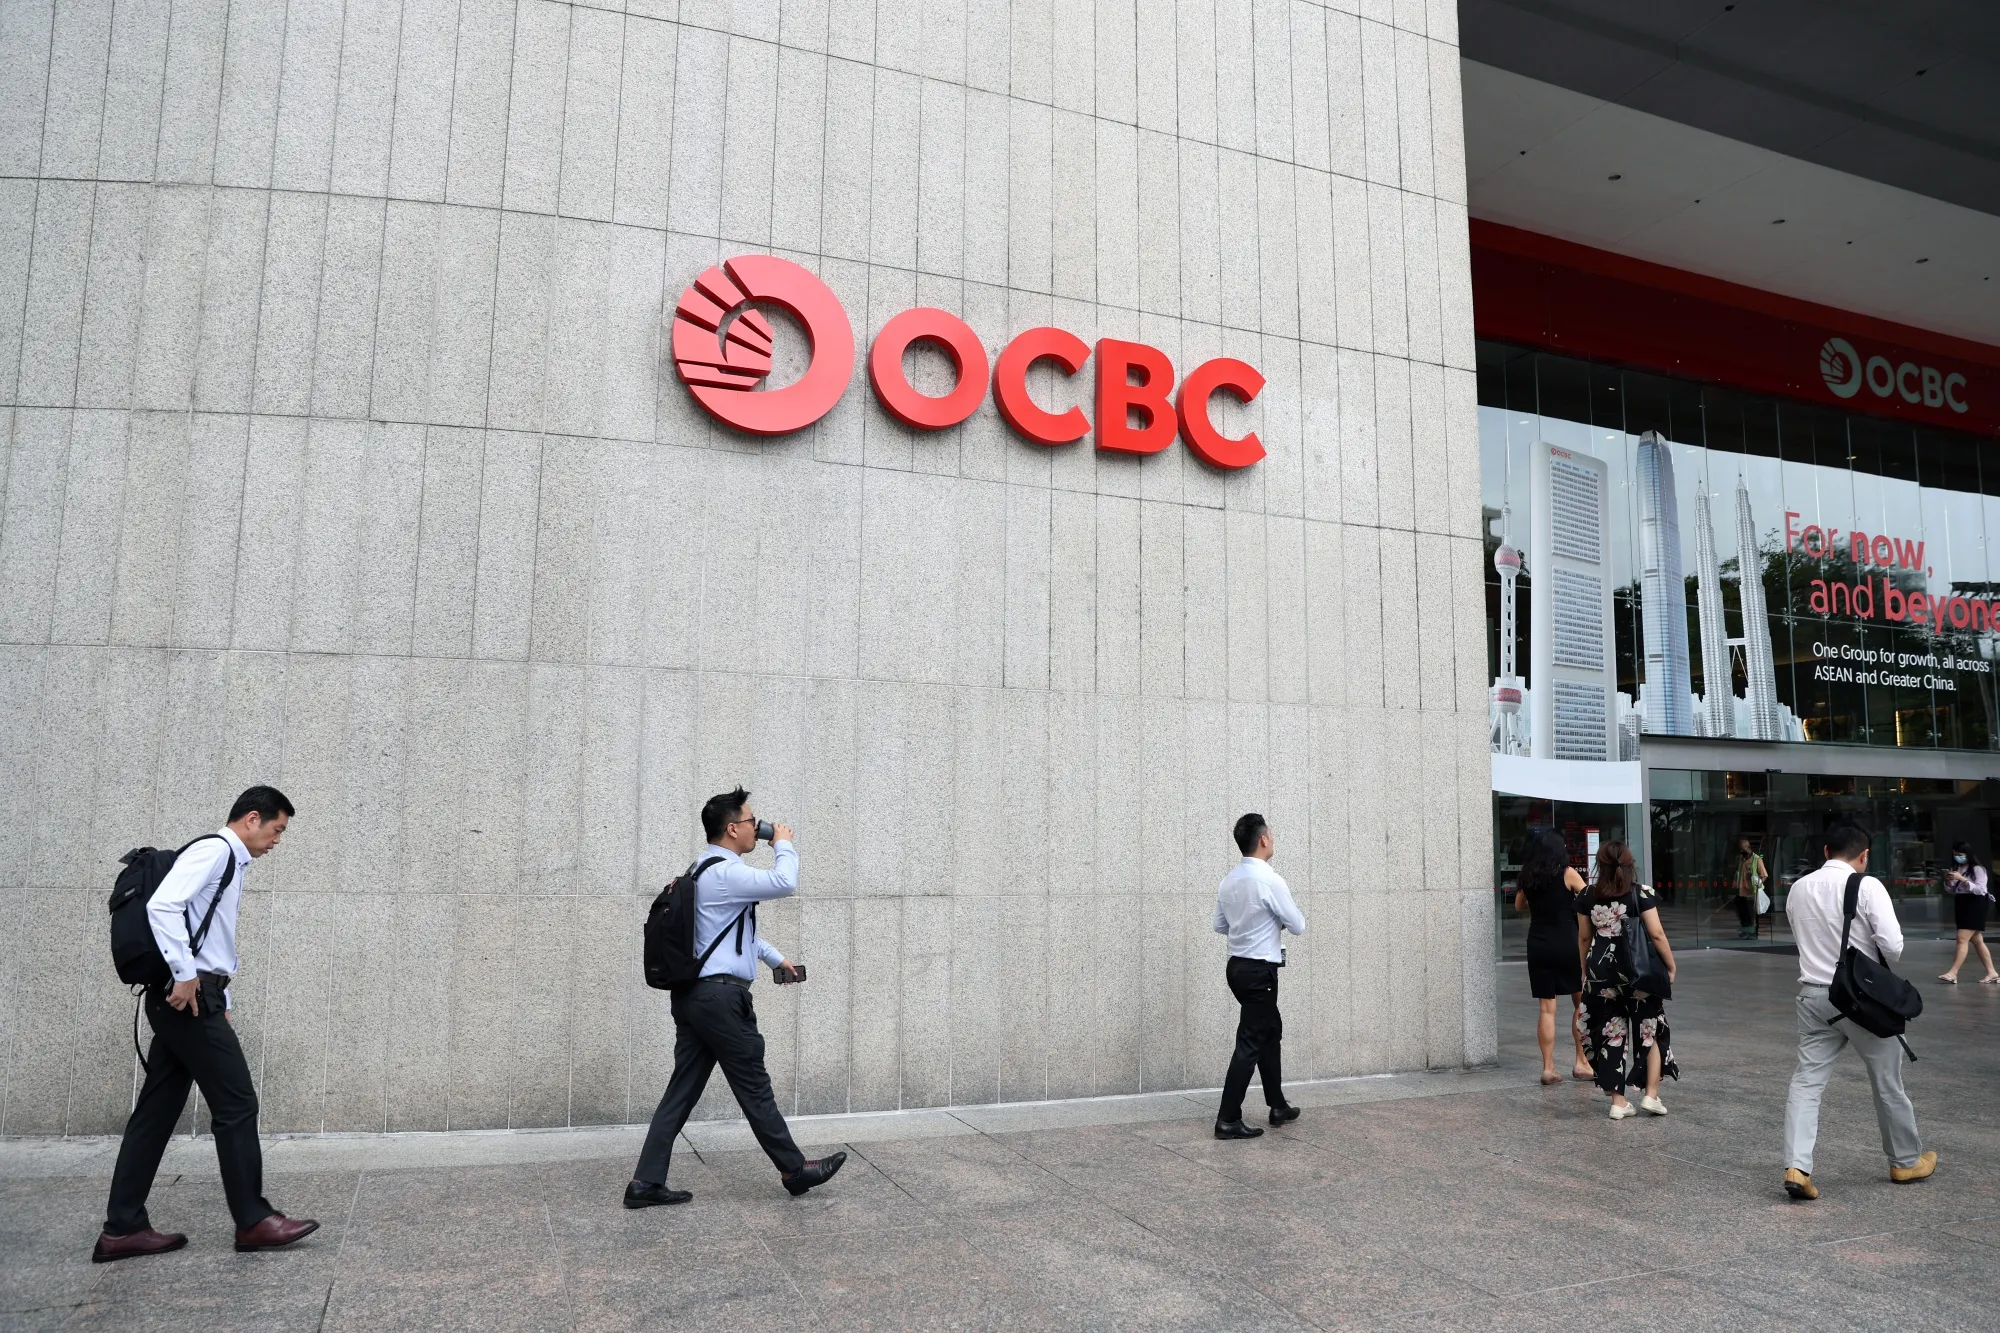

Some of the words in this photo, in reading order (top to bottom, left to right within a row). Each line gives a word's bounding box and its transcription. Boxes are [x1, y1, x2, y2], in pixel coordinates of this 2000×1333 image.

[868, 307, 1267, 471] OCBC
[1866, 355, 1969, 413] OCBC
[1785, 511, 1838, 559] For
[1850, 530, 1933, 578] now,
[1810, 574, 1875, 618] and
[1812, 641, 1839, 658] One
[1841, 644, 1878, 665] Group
[1879, 647, 1896, 664] for
[1898, 652, 1941, 670] growth,
[1942, 654, 1955, 669] all
[1956, 658, 1990, 673] across
[1814, 665, 1853, 683] ASEAN
[1855, 669, 1878, 685] and
[1879, 670, 1921, 688] Greater
[1923, 674, 1957, 691] China.
